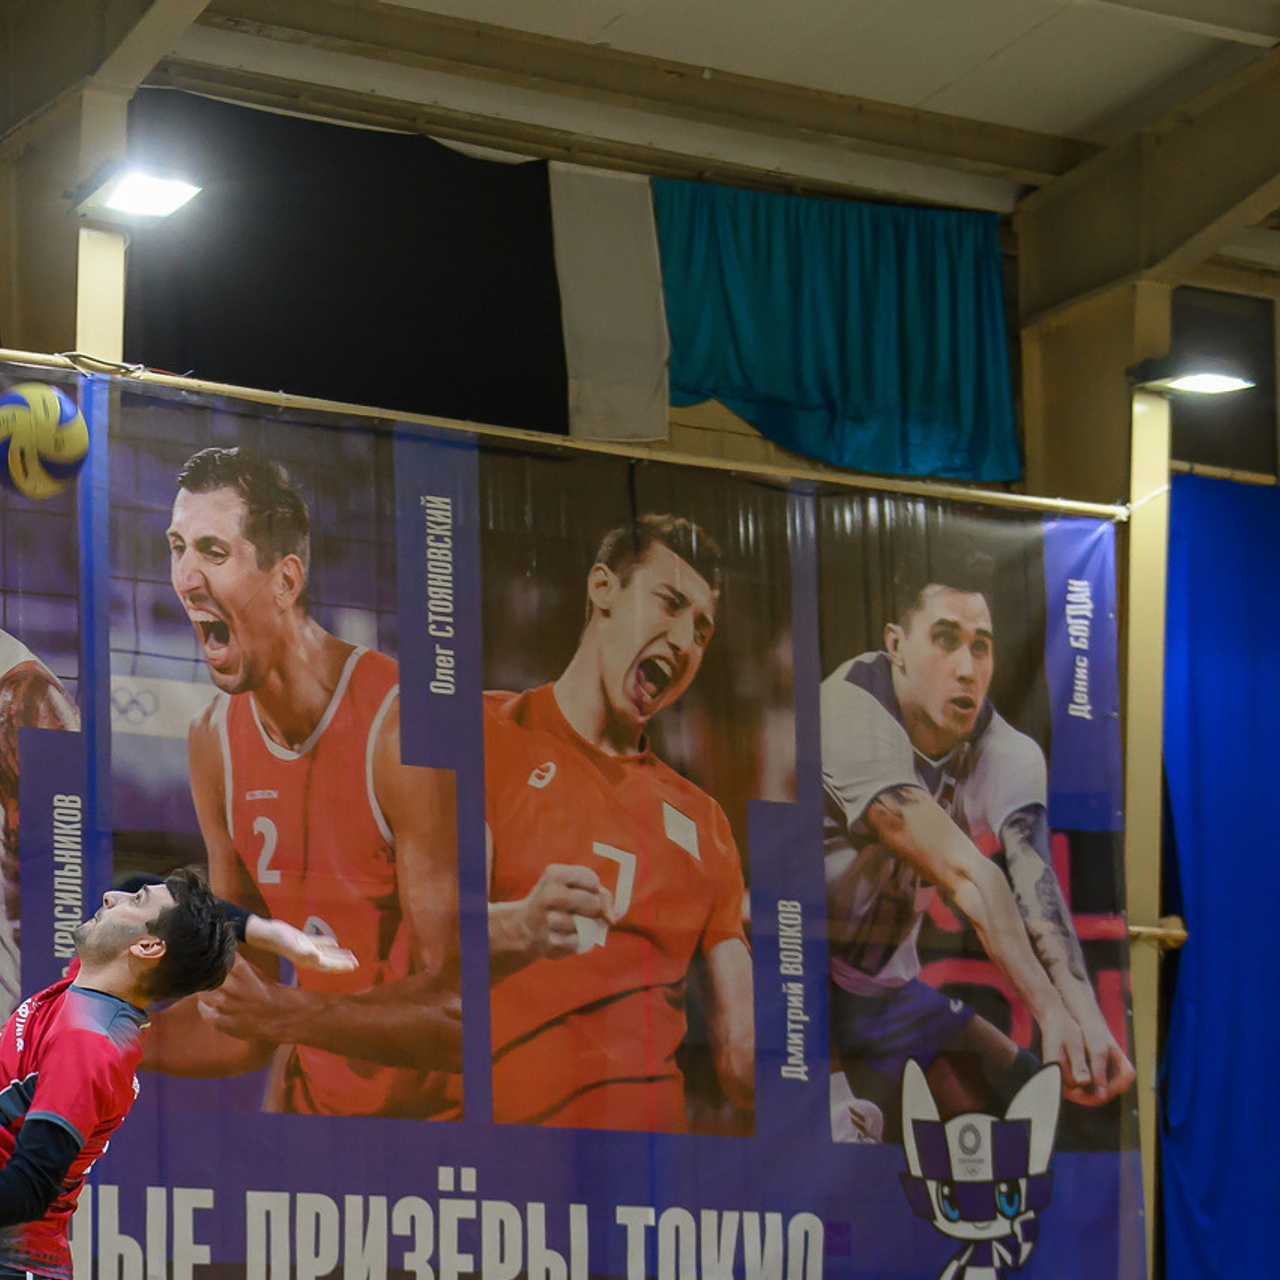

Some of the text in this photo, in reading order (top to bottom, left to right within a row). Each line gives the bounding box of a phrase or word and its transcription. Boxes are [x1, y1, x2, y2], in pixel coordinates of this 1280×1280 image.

[420, 496, 455, 695] Олег СТОЯНОВСКИЙ
[1066, 579, 1093, 720] Денис БОГДАН
[253, 816, 281, 884] 2
[778, 900, 810, 1081] Дмитрий ВОЛКОВ
